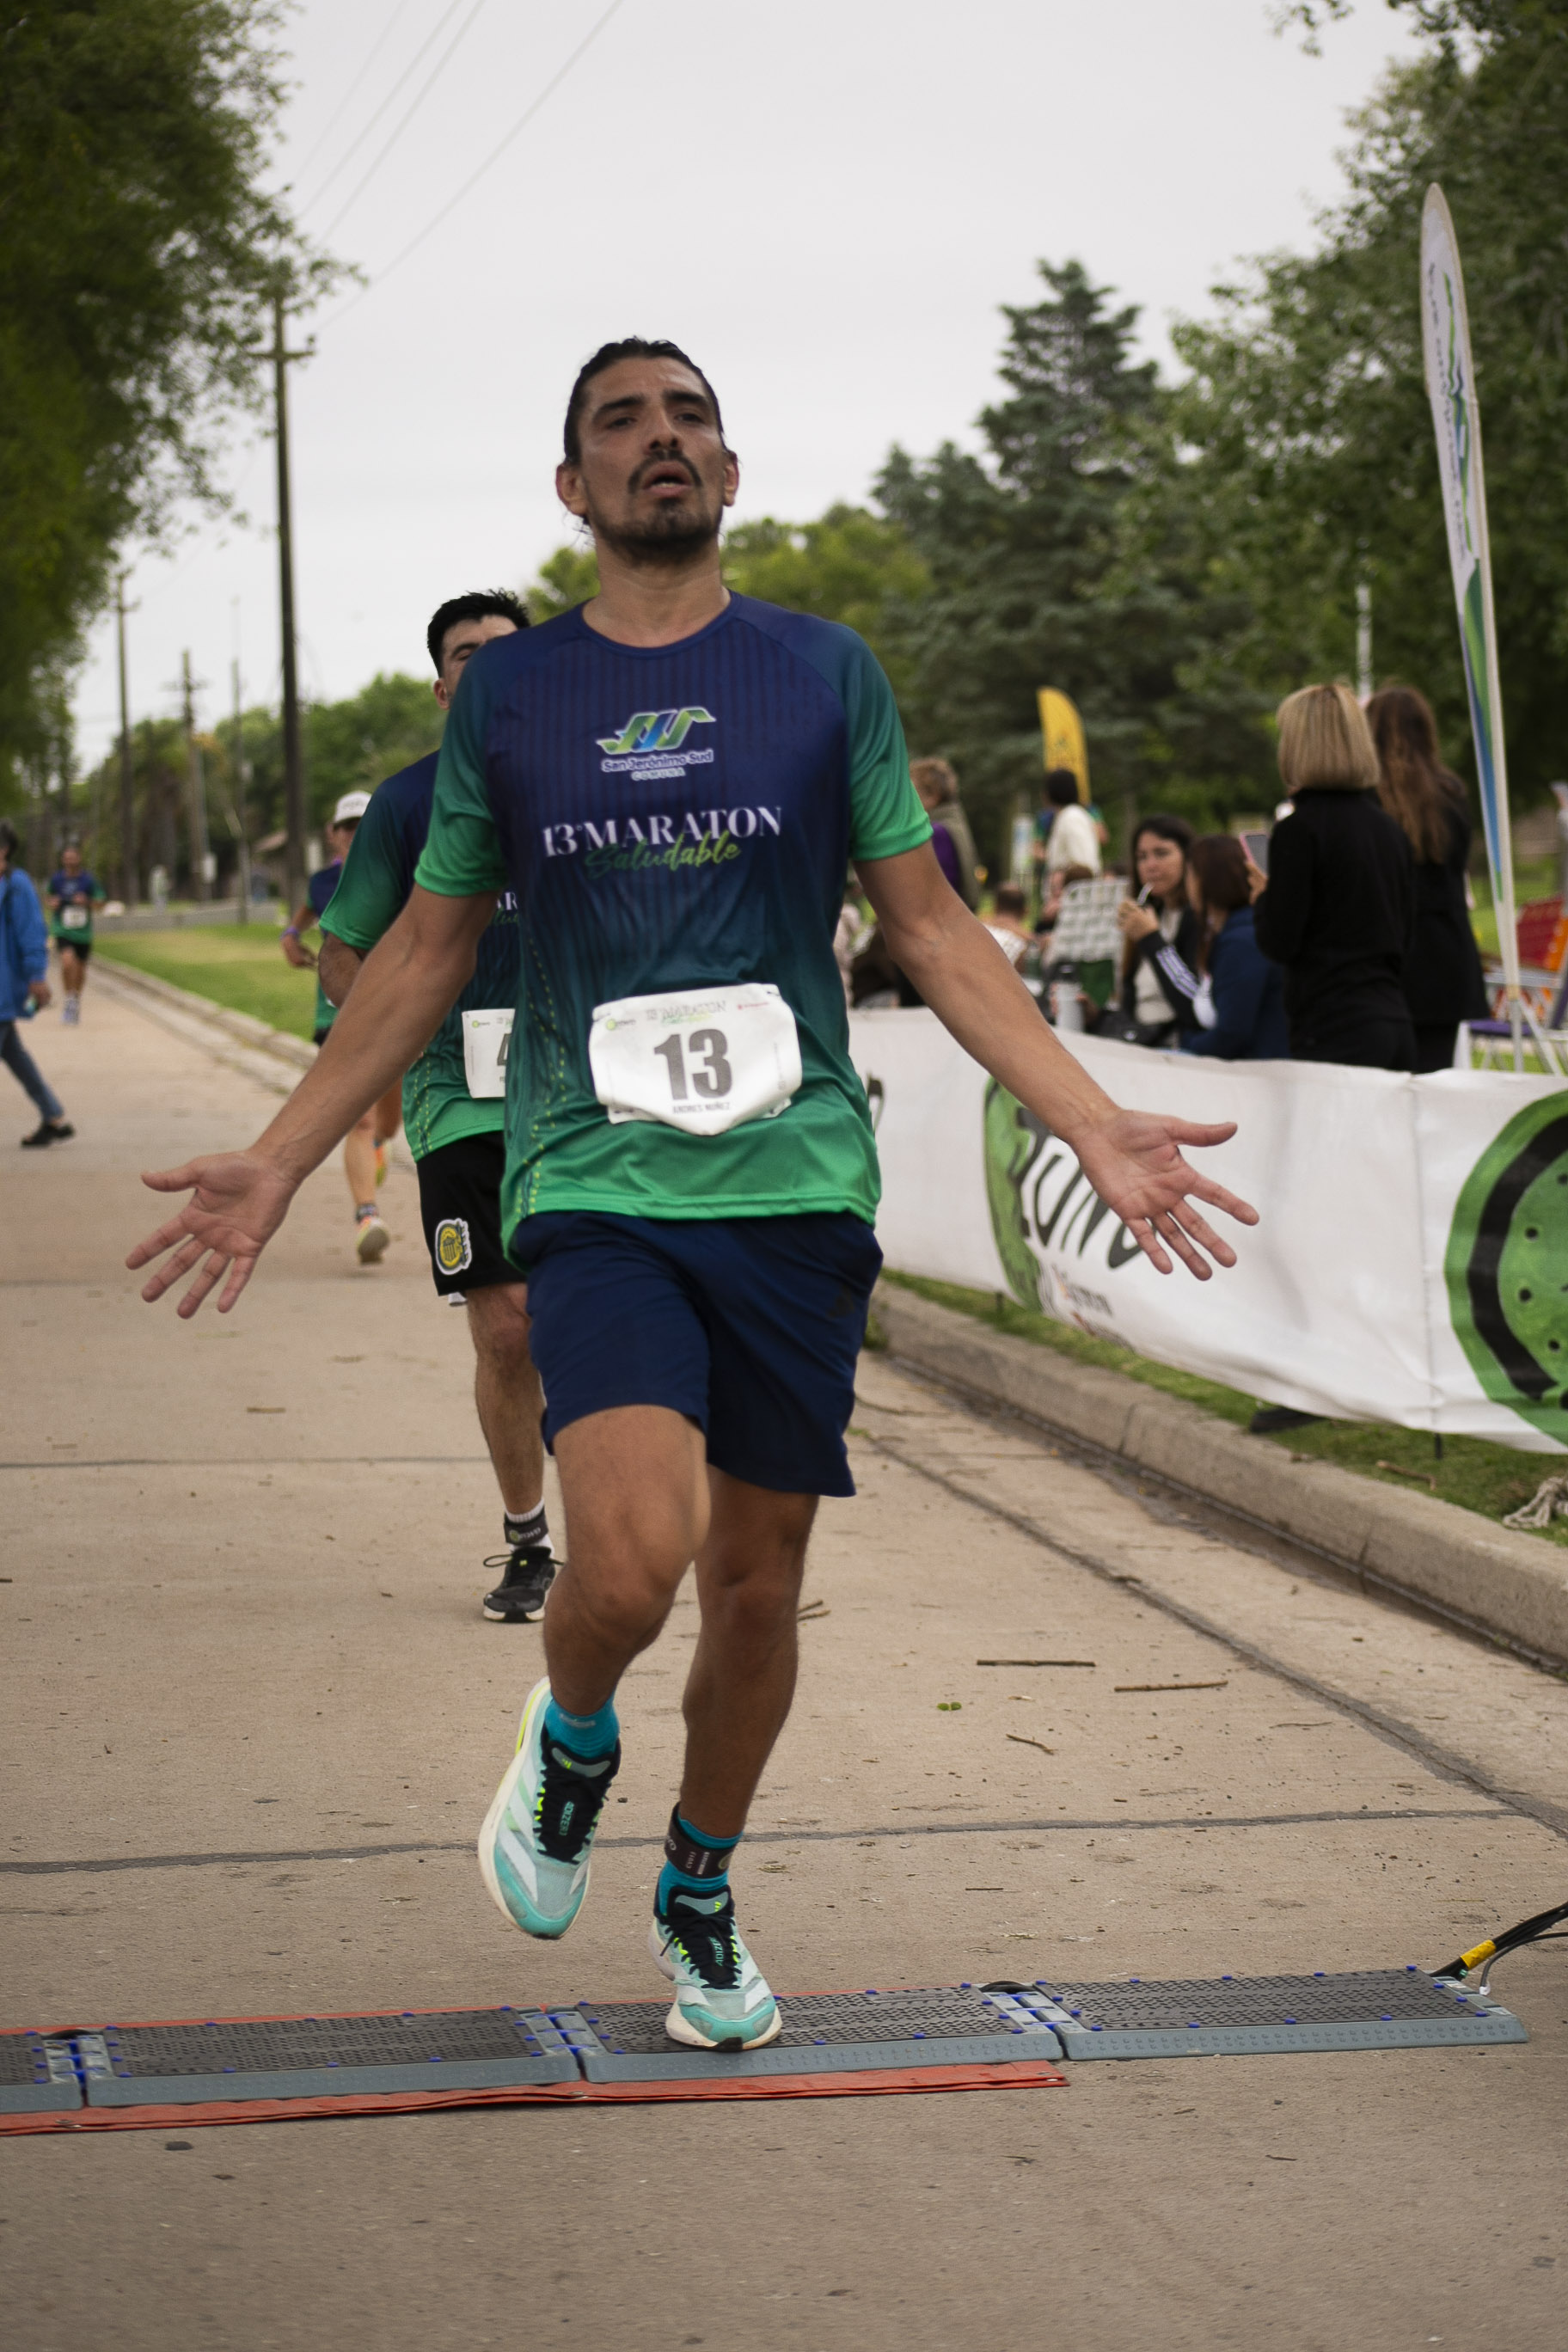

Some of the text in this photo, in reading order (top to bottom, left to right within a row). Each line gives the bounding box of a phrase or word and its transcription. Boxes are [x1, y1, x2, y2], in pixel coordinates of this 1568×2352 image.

[603, 758, 627, 771] San
[689, 749, 714, 763] Sud
[584, 830, 741, 879] Saludable
[653, 1028, 732, 1100] 13
